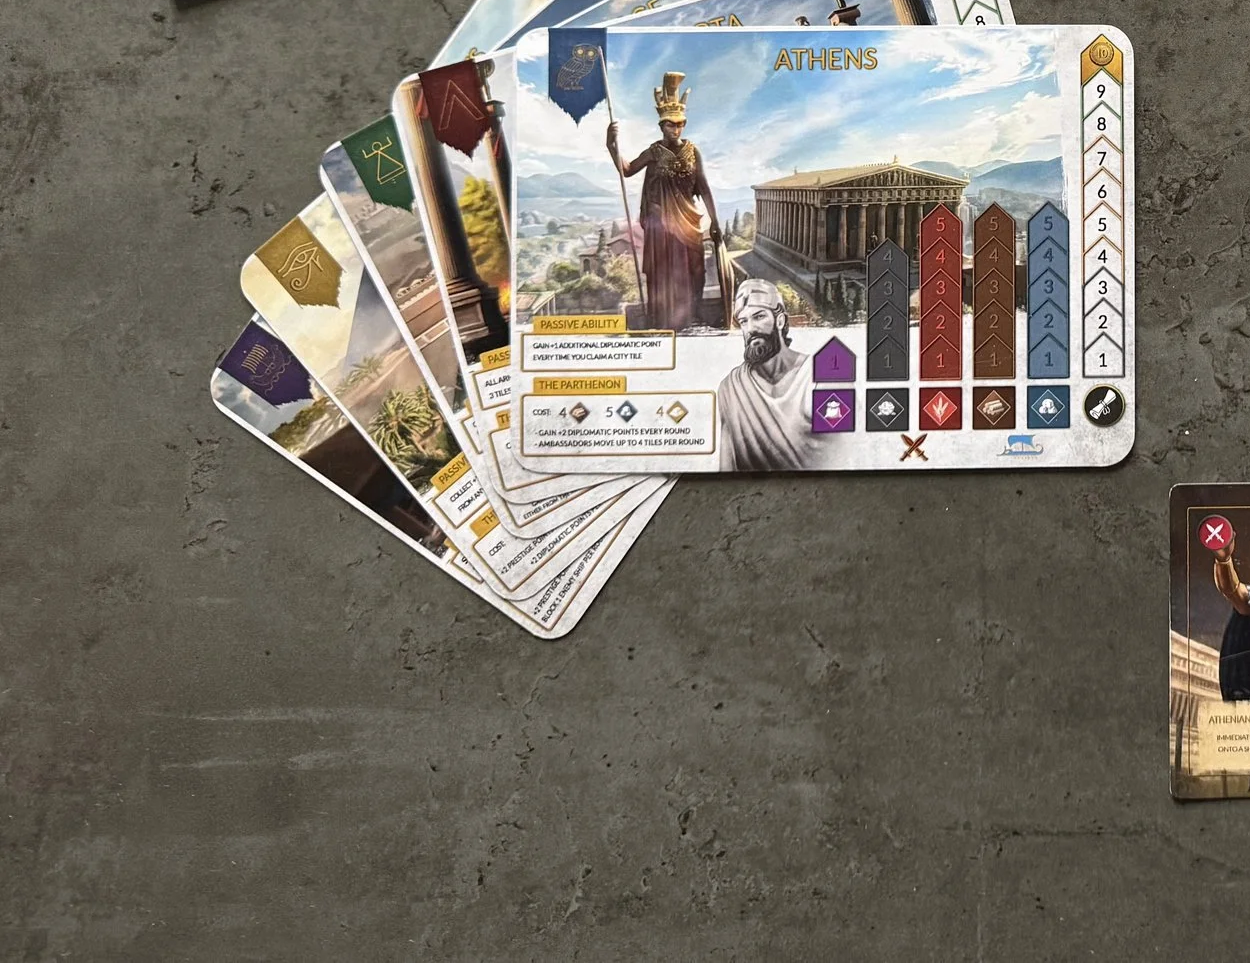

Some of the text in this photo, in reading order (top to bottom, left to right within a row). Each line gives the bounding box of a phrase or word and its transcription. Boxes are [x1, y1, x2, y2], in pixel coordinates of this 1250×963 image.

[773, 47, 879, 72] ATHENS
[1096, 84, 1106, 99] 9
[1096, 117, 1107, 132] 8
[1097, 151, 1107, 166] 7
[1097, 184, 1108, 199] 6
[1097, 218, 1107, 232] 5
[1097, 250, 1108, 265] 4
[1098, 280, 1108, 296] 3
[540, 319, 619, 329] PASSIVE ABILITY
[1098, 315, 1108, 330] 2
[1099, 353, 1108, 368] 1
[539, 380, 621, 390] THE PARTHENON
[558, 407, 567, 416] 4
[606, 407, 614, 417] 5
[656, 407, 664, 416] 4
[567, 428, 612, 436] DIPLOMATIC
[613, 428, 639, 436] POINTS
[538, 439, 592, 447] AMBASSADORS
[593, 439, 615, 447] MOVE
[678, 438, 705, 446] ROUND
[1208, 715, 1250, 724] ATHENIAN
